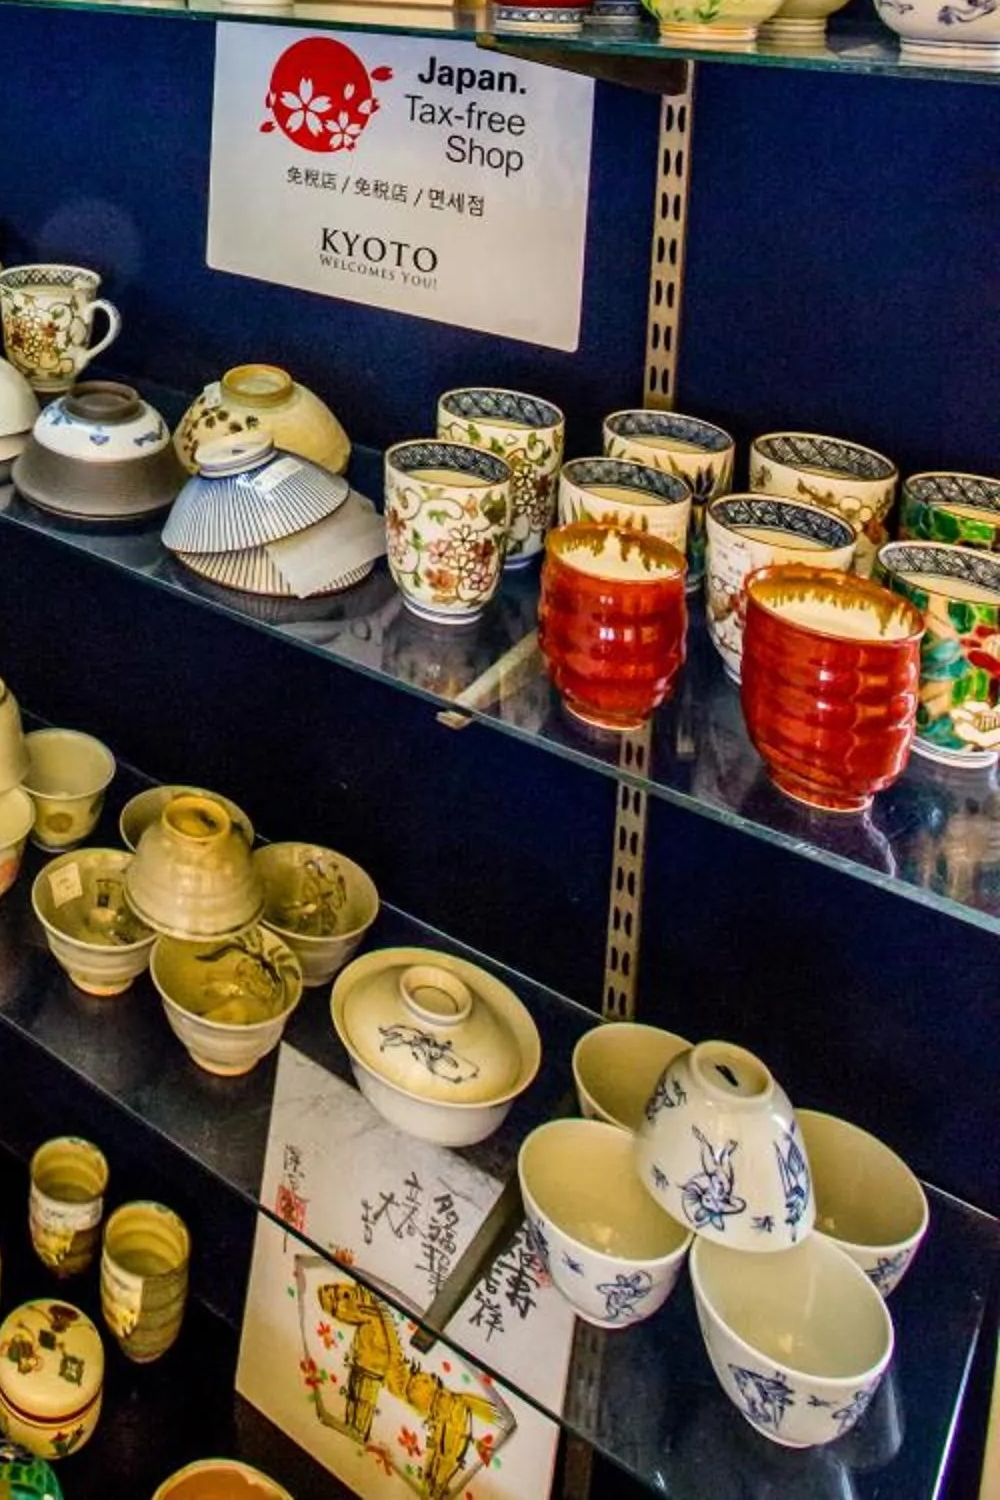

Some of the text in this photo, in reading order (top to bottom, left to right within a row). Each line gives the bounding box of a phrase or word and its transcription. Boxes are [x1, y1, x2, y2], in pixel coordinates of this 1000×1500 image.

[418, 56, 526, 94] Japan.
[404, 94, 526, 136] Tax-free
[445, 135, 524, 177] Shop
[428, 188, 485, 217] 면세점
[321, 227, 438, 273] KYOTO
[319, 253, 438, 290] WELCOMES YOU!
